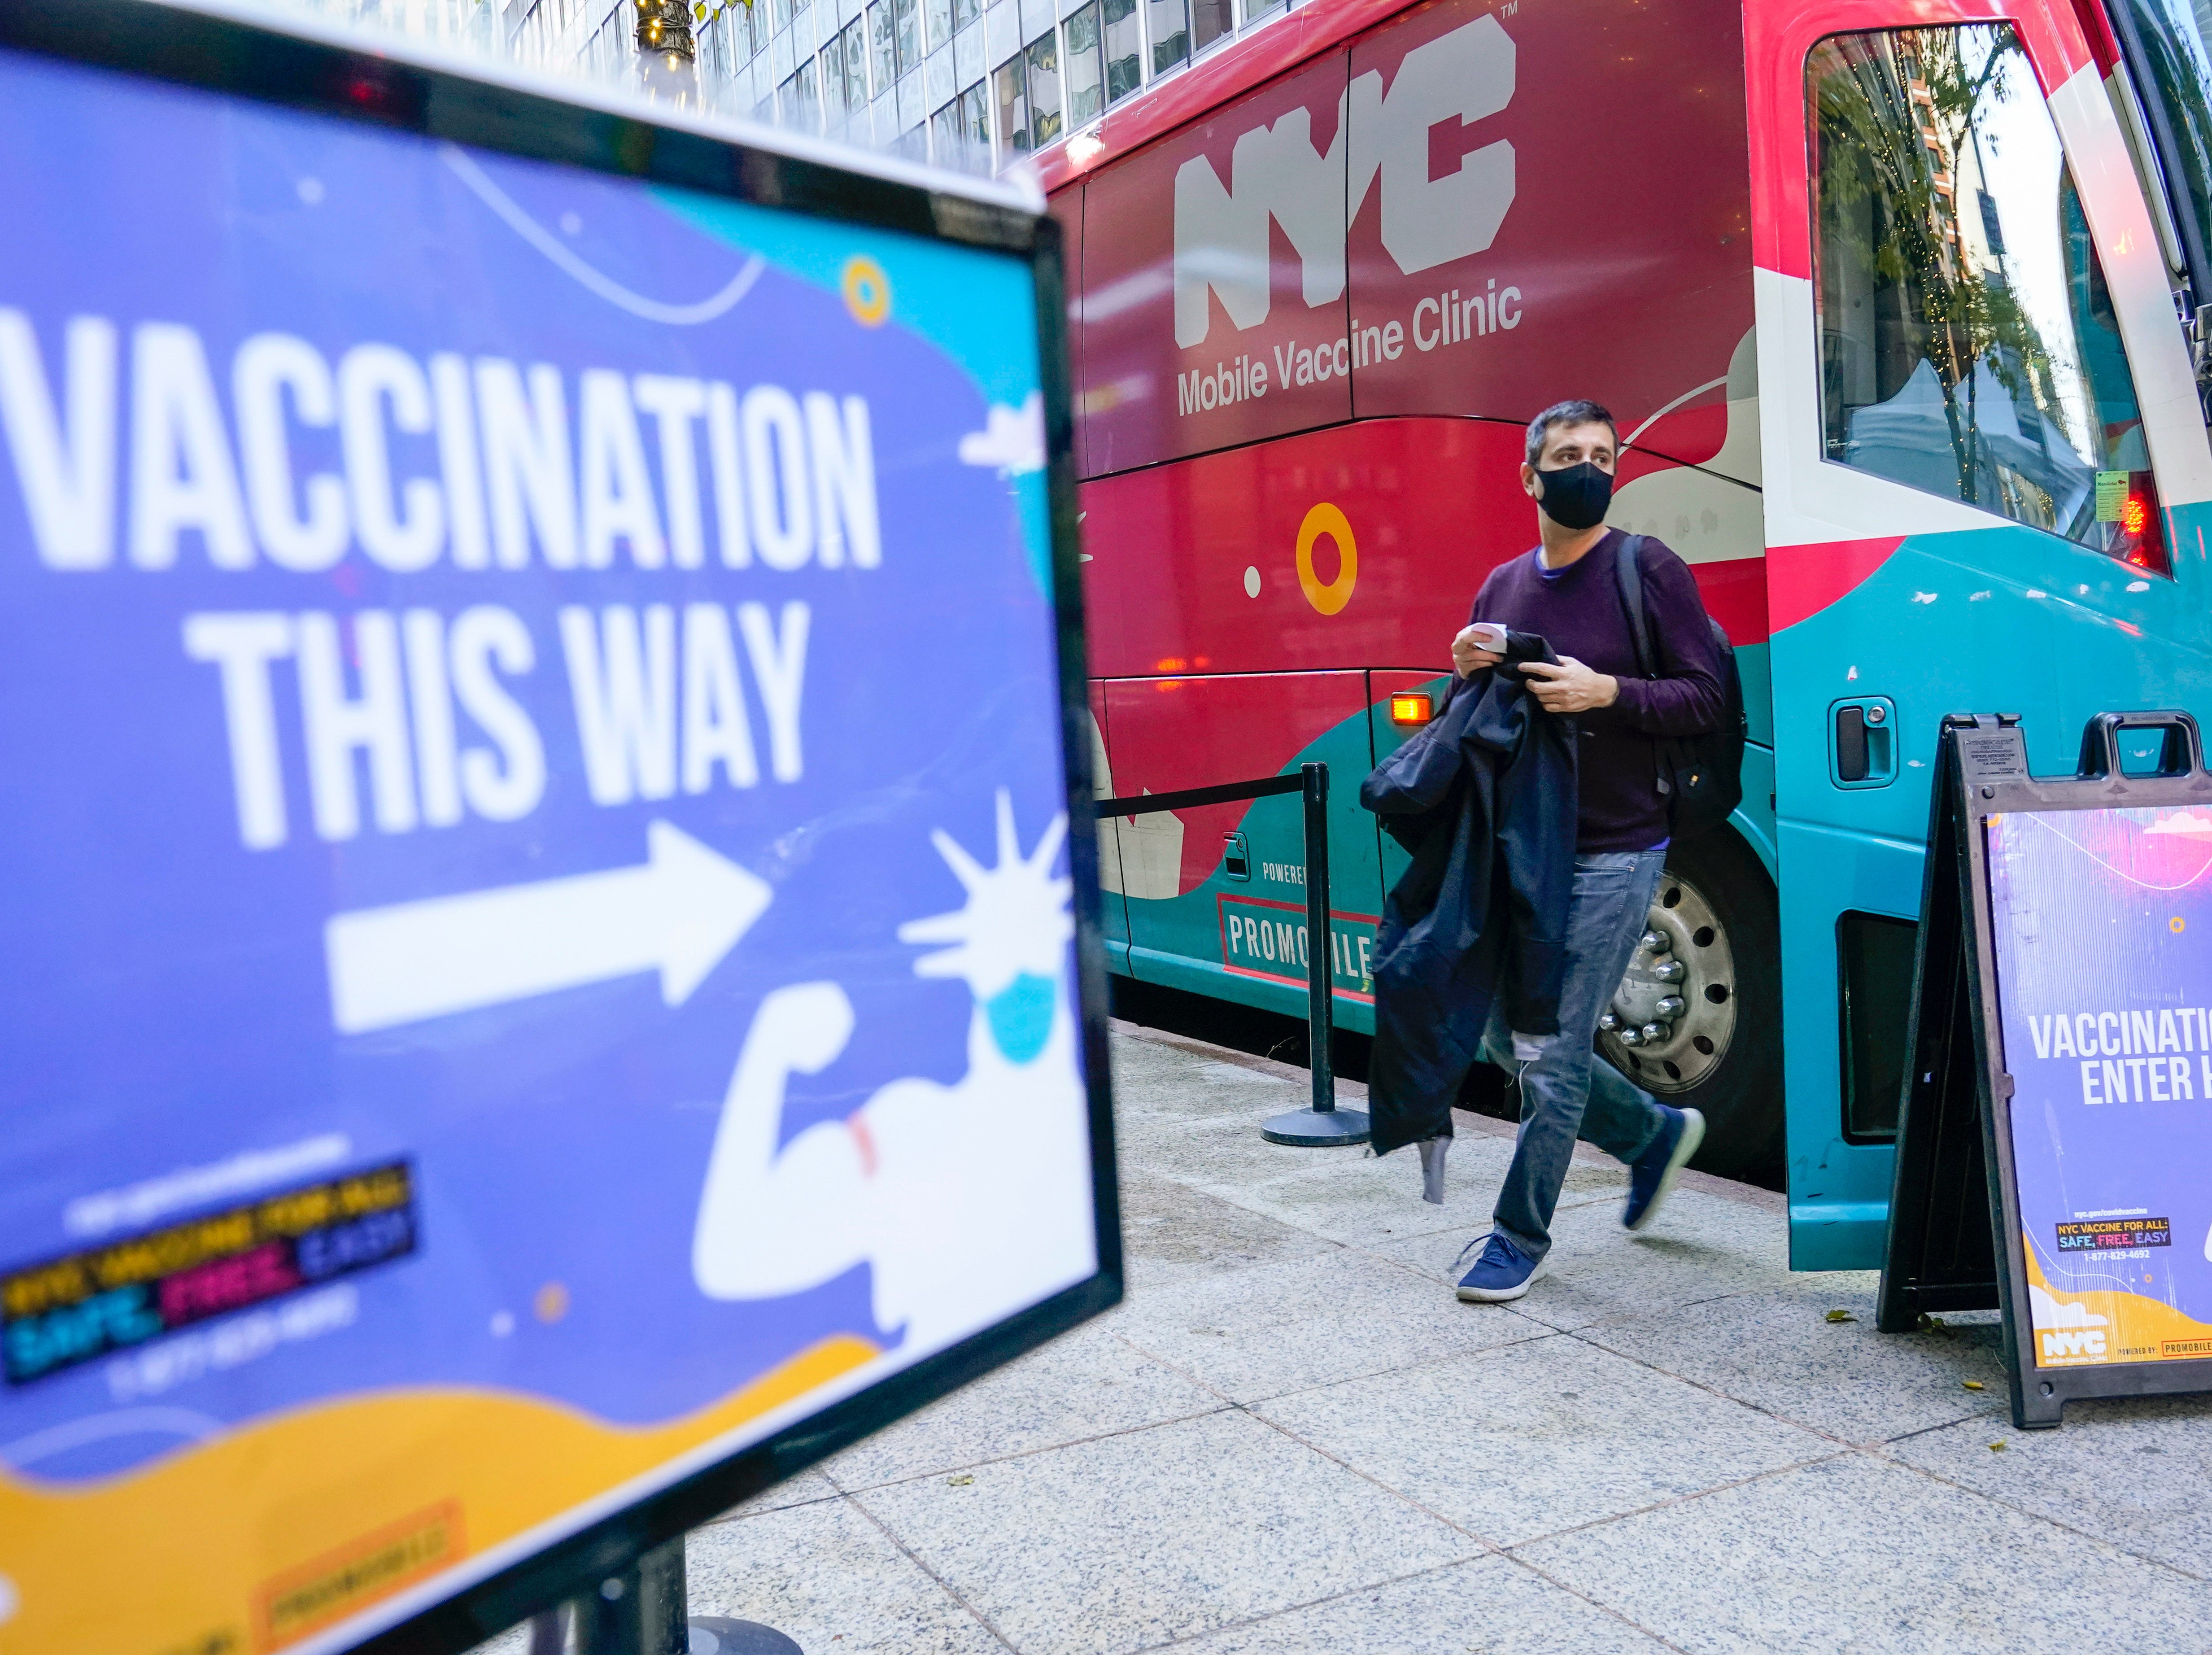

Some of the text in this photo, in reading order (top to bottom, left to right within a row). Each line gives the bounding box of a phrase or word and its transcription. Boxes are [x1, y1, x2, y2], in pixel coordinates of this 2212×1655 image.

[1174, 13, 1516, 349] NYC
[1178, 278, 1523, 417] Mobile Vaccine Clinic
[0, 307, 881, 571] VACCINATION
[183, 600, 811, 851] THIS WAY
[1229, 914, 1374, 980] PROMOILE
[2028, 1008, 2212, 1059] VACCINATI
[2081, 1056, 2194, 1105] ENTER
[2058, 1219, 2168, 1235] NYC VACCINE FOR ALL:
[2059, 1231, 2168, 1249] SAFE, FREE, EASY
[2042, 1331, 2107, 1357] NYC
[2117, 1347, 2146, 1355] POWERED
[2165, 1342, 2212, 1353] PROMOBILE
